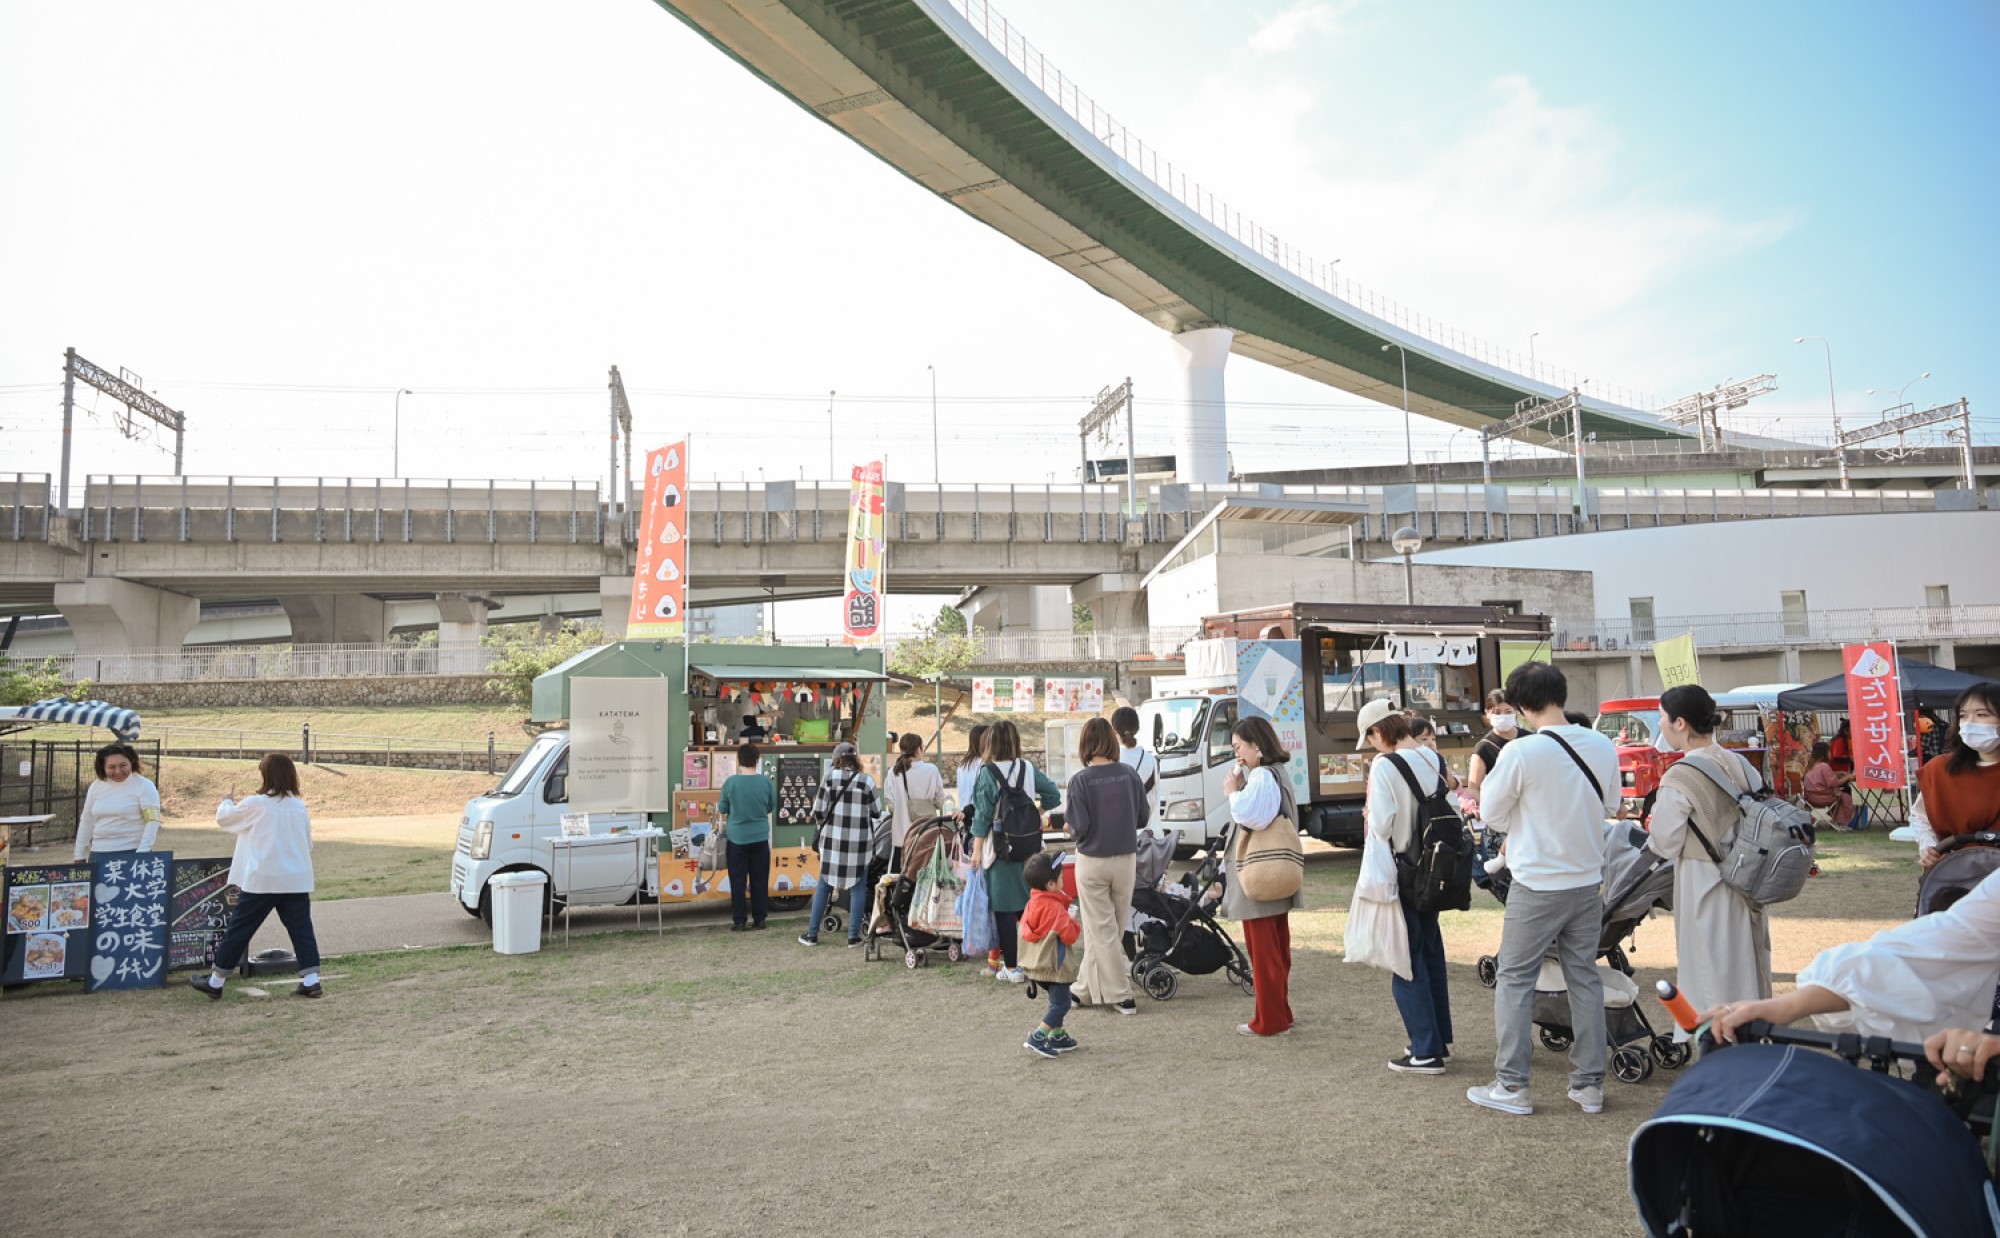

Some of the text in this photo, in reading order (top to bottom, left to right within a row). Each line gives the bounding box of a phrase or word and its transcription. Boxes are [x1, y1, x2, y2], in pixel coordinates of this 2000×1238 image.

[599, 710, 641, 718] KATATEMA
[1281, 730, 1297, 740] ICE
[1281, 740, 1303, 750] REAM
[104, 860, 127, 884] 某
[130, 857, 164, 880] 体育
[125, 878, 167, 900] 大学
[95, 903, 167, 928] 学生食堂
[200, 899, 224, 915] から
[21, 919, 41, 928] 500
[96, 929, 164, 954] の味
[116, 955, 162, 982] チキン
